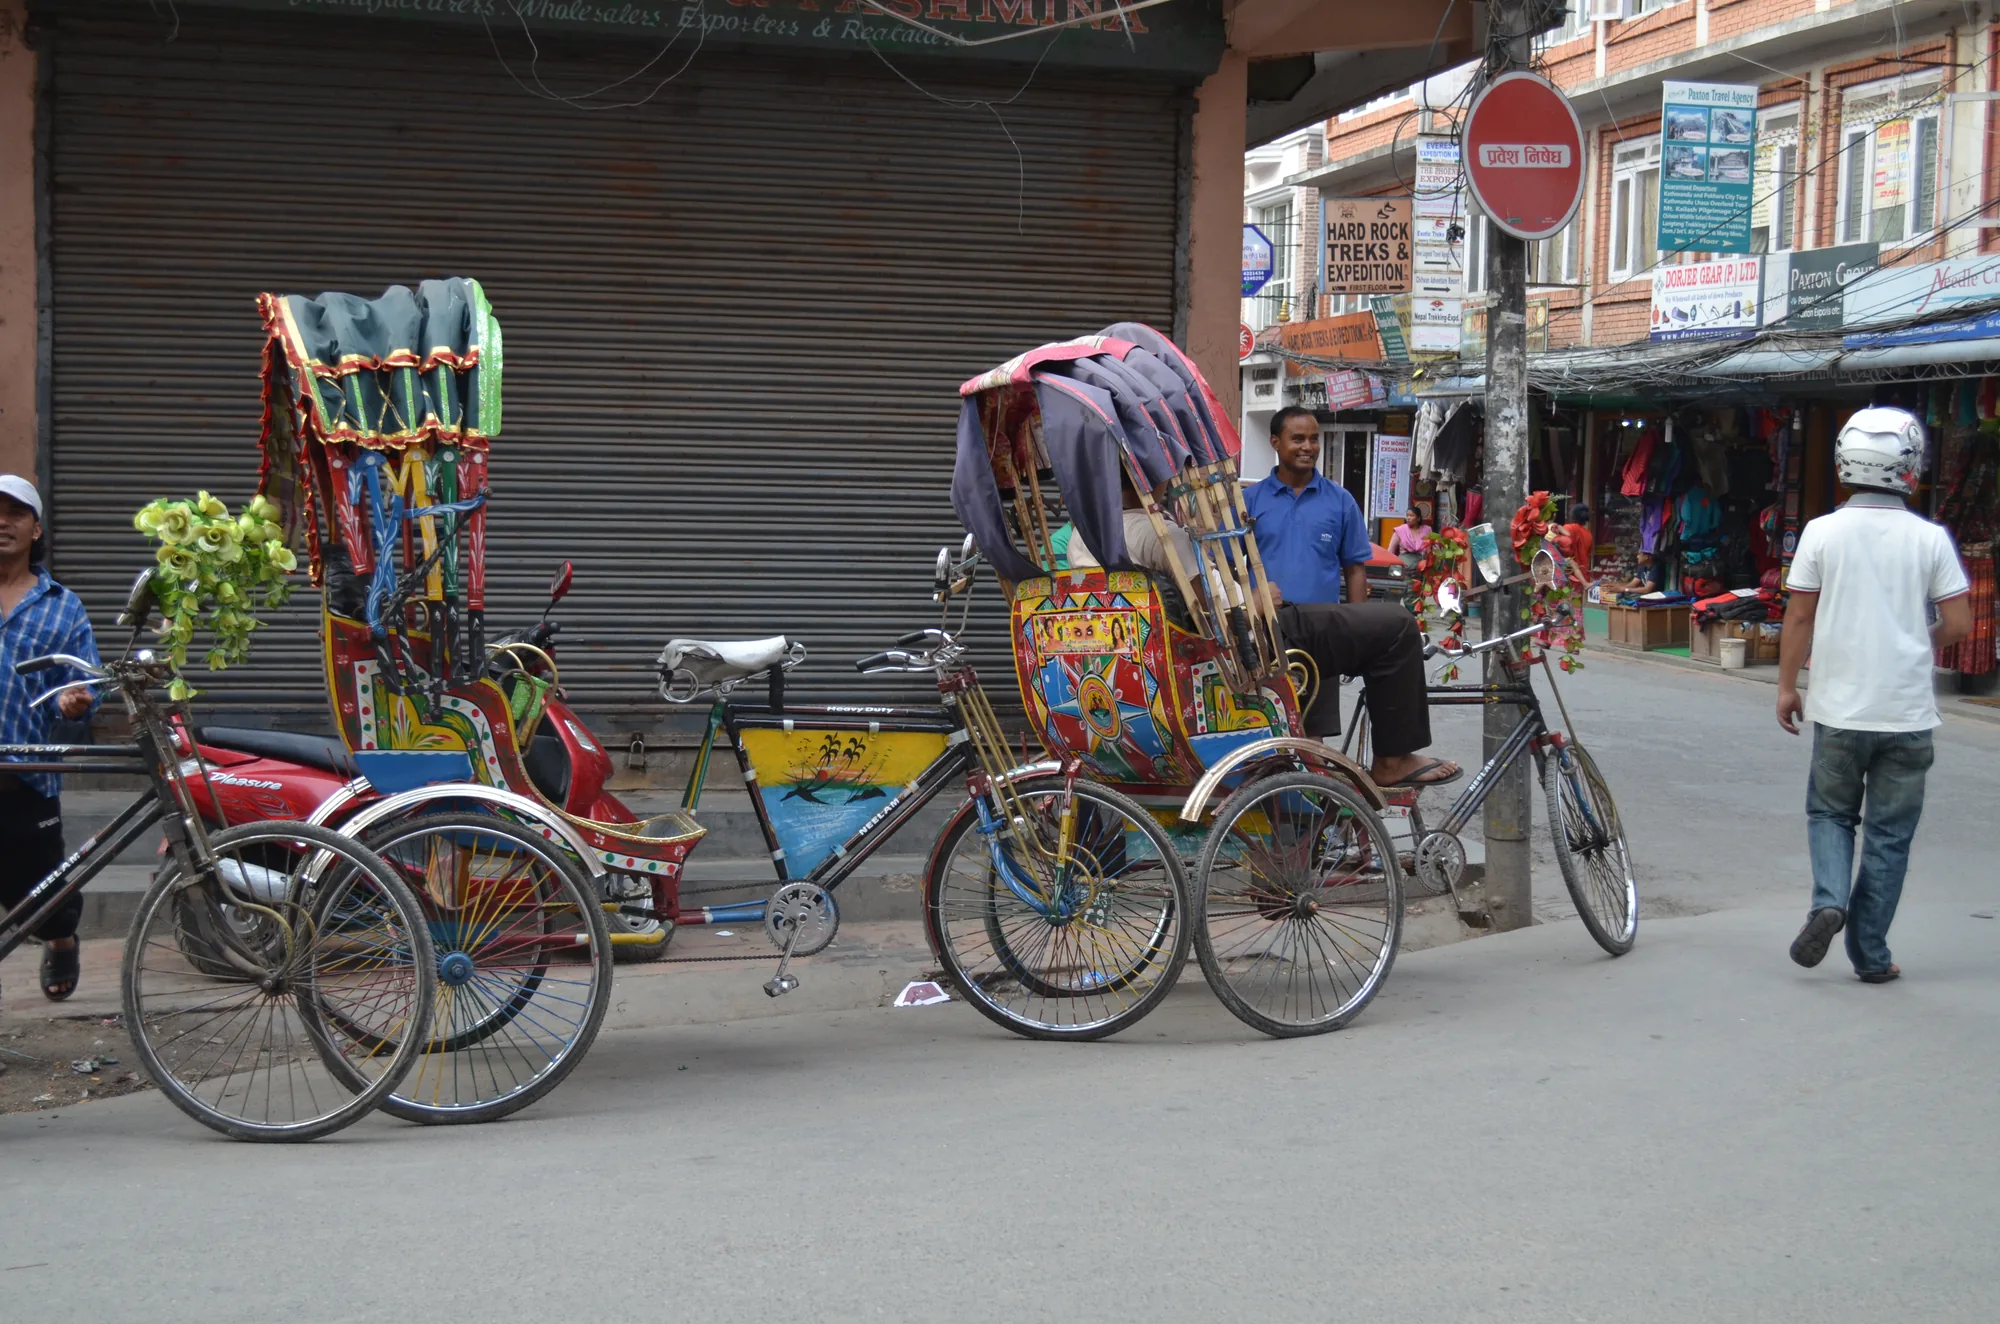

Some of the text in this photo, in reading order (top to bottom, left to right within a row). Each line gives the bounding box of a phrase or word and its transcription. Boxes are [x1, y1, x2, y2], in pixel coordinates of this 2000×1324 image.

[677, 5, 799, 37] Exporters
[811, 17, 834, 38] &
[1688, 88, 1710, 101] Paxton
[1711, 89, 1730, 102] Travel
[1732, 90, 1754, 106] Agency
[1420, 150, 1452, 158] EXPEDITION
[1487, 145, 1562, 166] प्रवेश निषेध
[1420, 166, 1434, 174] THE
[1327, 222, 1409, 240] HARD ROCK
[1327, 242, 1409, 262] TREKS &
[1328, 263, 1403, 282] EXPEDITION
[1665, 261, 1758, 288] DORJEE GEAR (P.) LTD.
[1791, 268, 1832, 290] PAXTON
[1349, 284, 1388, 292] FIRST FLOOR
[1916, 266, 1978, 313] Needle
[1798, 296, 1814, 304] Paxton
[1798, 308, 1814, 318] axton
[1814, 307, 1831, 318] Exports
[1850, 460, 1884, 468] PAULO
[865, 706, 894, 714] Duty
[210, 772, 282, 790] Pleasure
[858, 798, 900, 836] NEELAM
[31, 852, 80, 898] NEELAM
